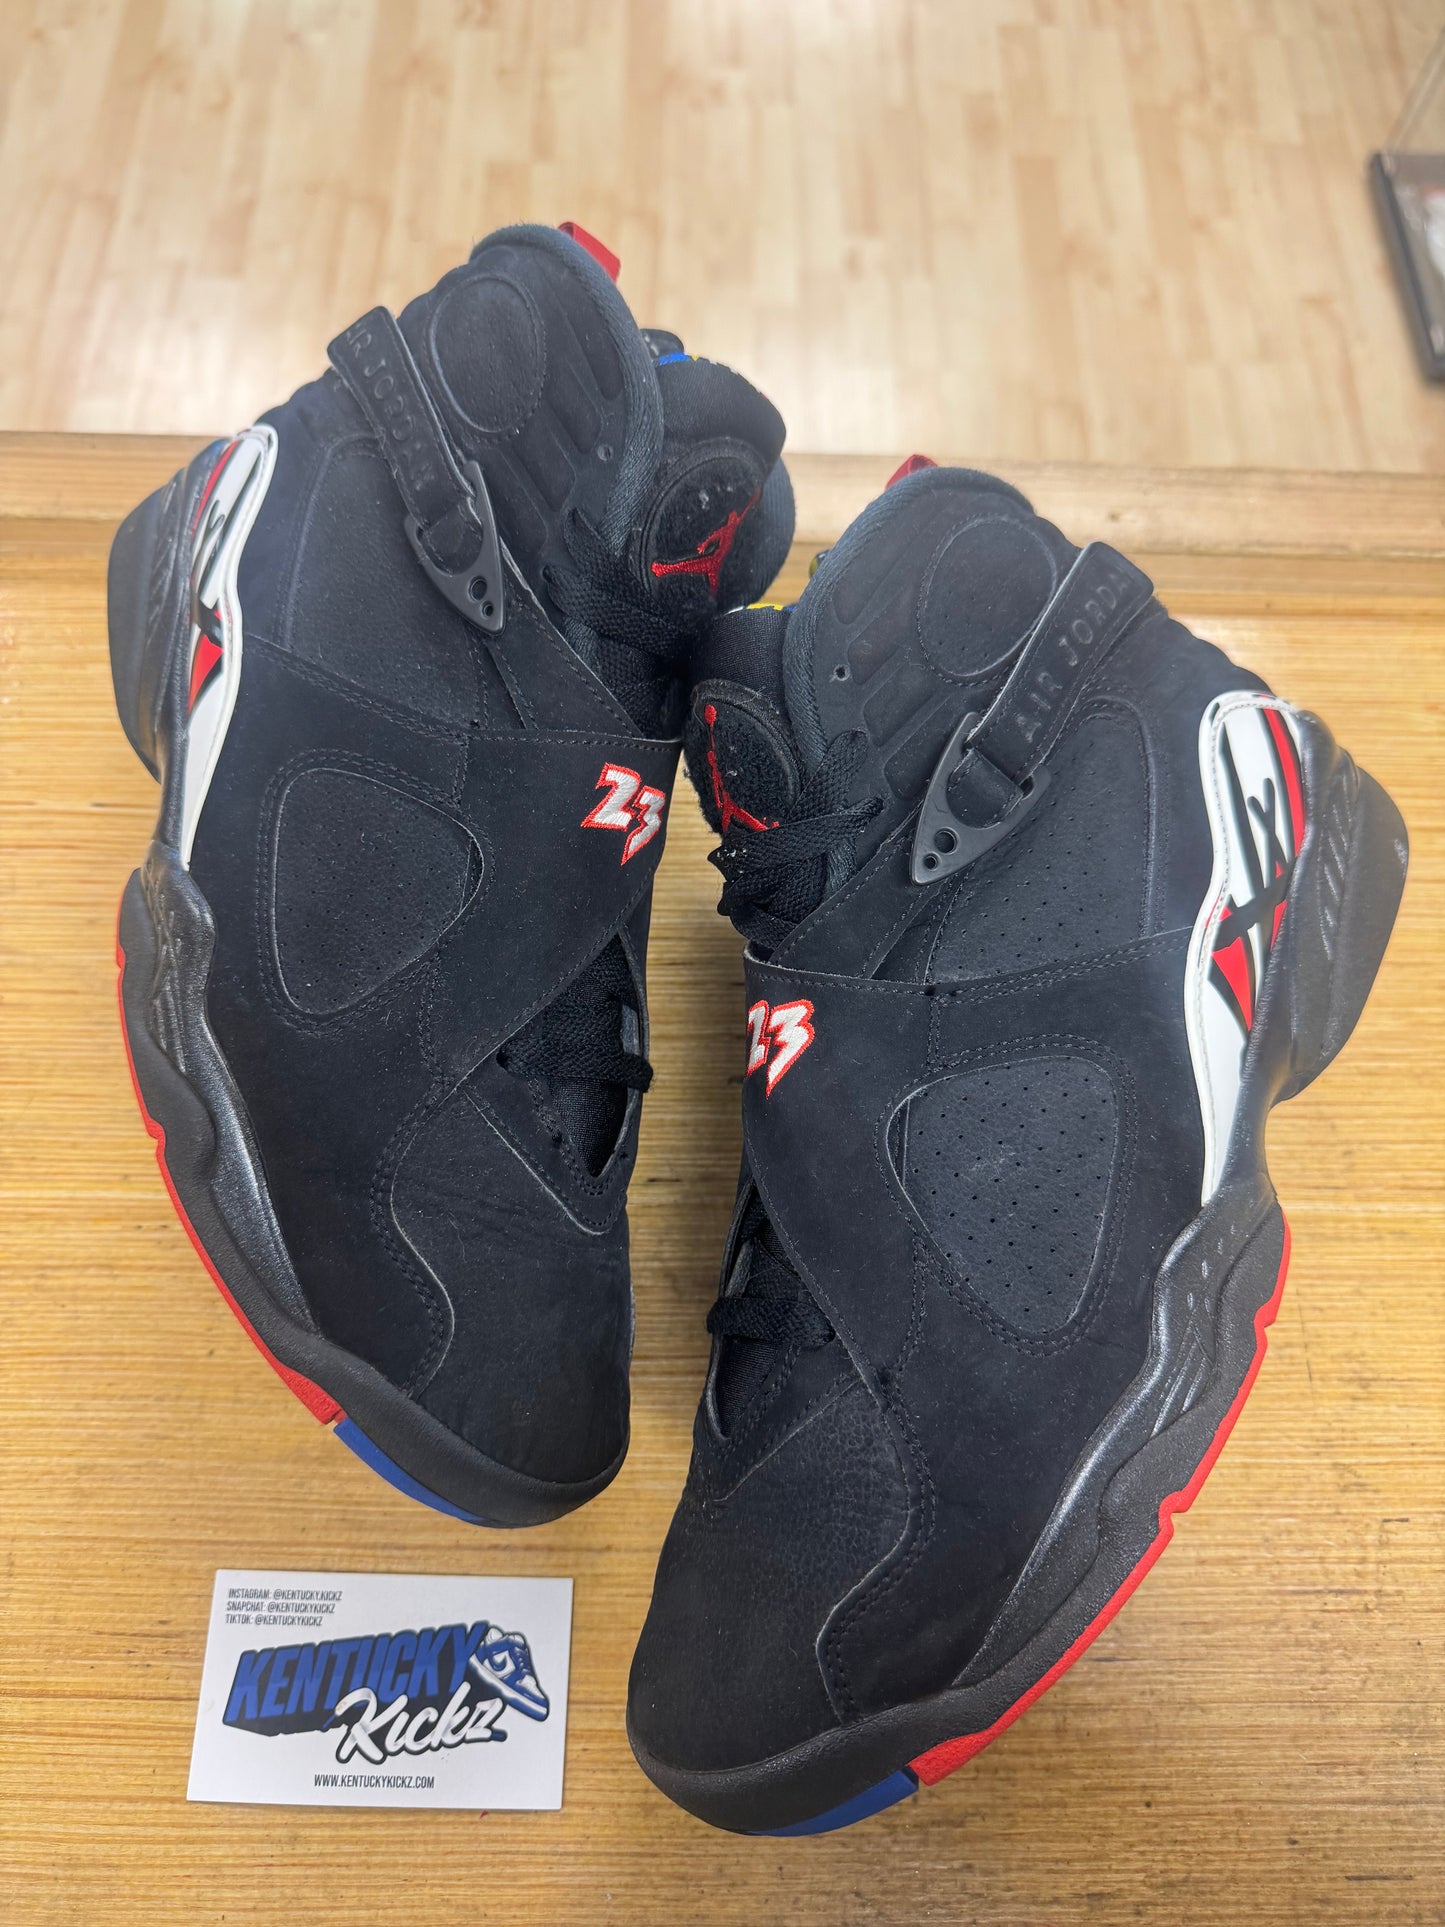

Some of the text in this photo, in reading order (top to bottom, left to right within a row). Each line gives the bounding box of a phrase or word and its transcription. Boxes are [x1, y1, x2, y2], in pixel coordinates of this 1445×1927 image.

[1015, 571, 1130, 744] AIR JORDA
[580, 762, 666, 866] 23
[226, 1600, 336, 1614] SNAPCHAT: @KENTUCKYKICKZ
[228, 1588, 272, 1600] INSTAGRAM:
[225, 1613, 324, 1627] TIKTOK: @KENTUCKYKICKZ
[225, 1621, 489, 1724] KENTUCKY
[334, 1680, 505, 1763] Kickz
[314, 1774, 435, 1789] WWW.KENTUCKYKICKZ.COM
